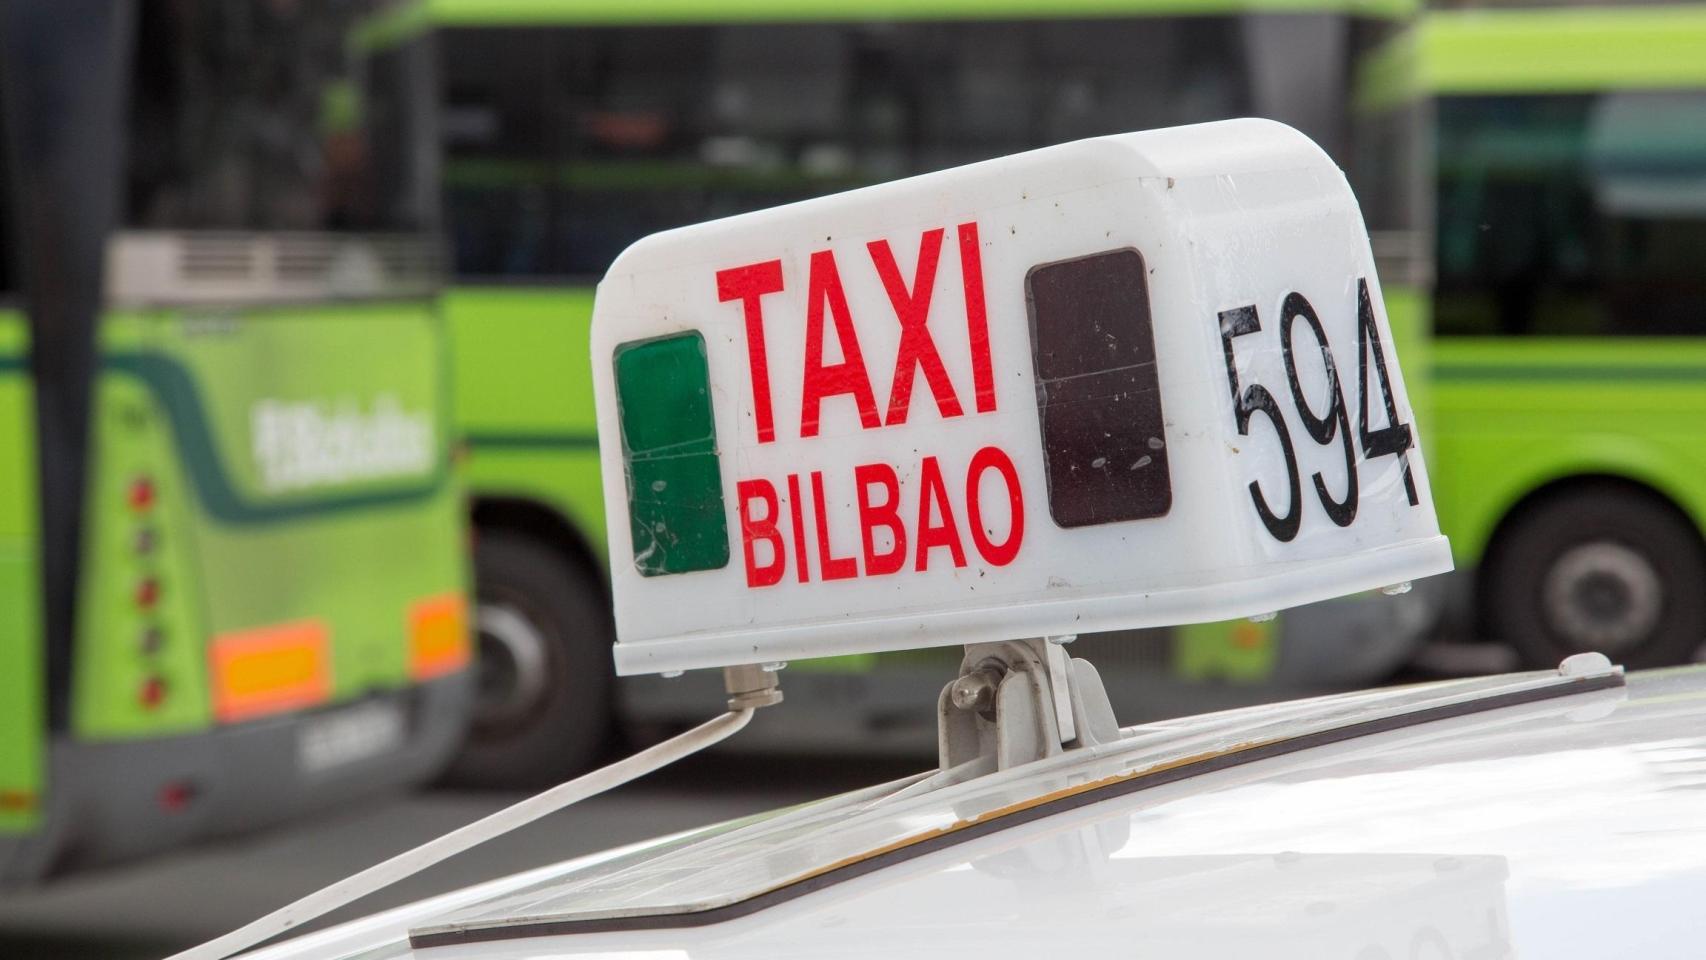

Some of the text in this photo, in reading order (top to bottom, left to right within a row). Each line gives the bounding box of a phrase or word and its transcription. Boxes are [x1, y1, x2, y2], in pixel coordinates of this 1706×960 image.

[716, 222, 997, 444] TAXI
[1217, 277, 1419, 542] 594
[736, 446, 1024, 588] BILBAO
